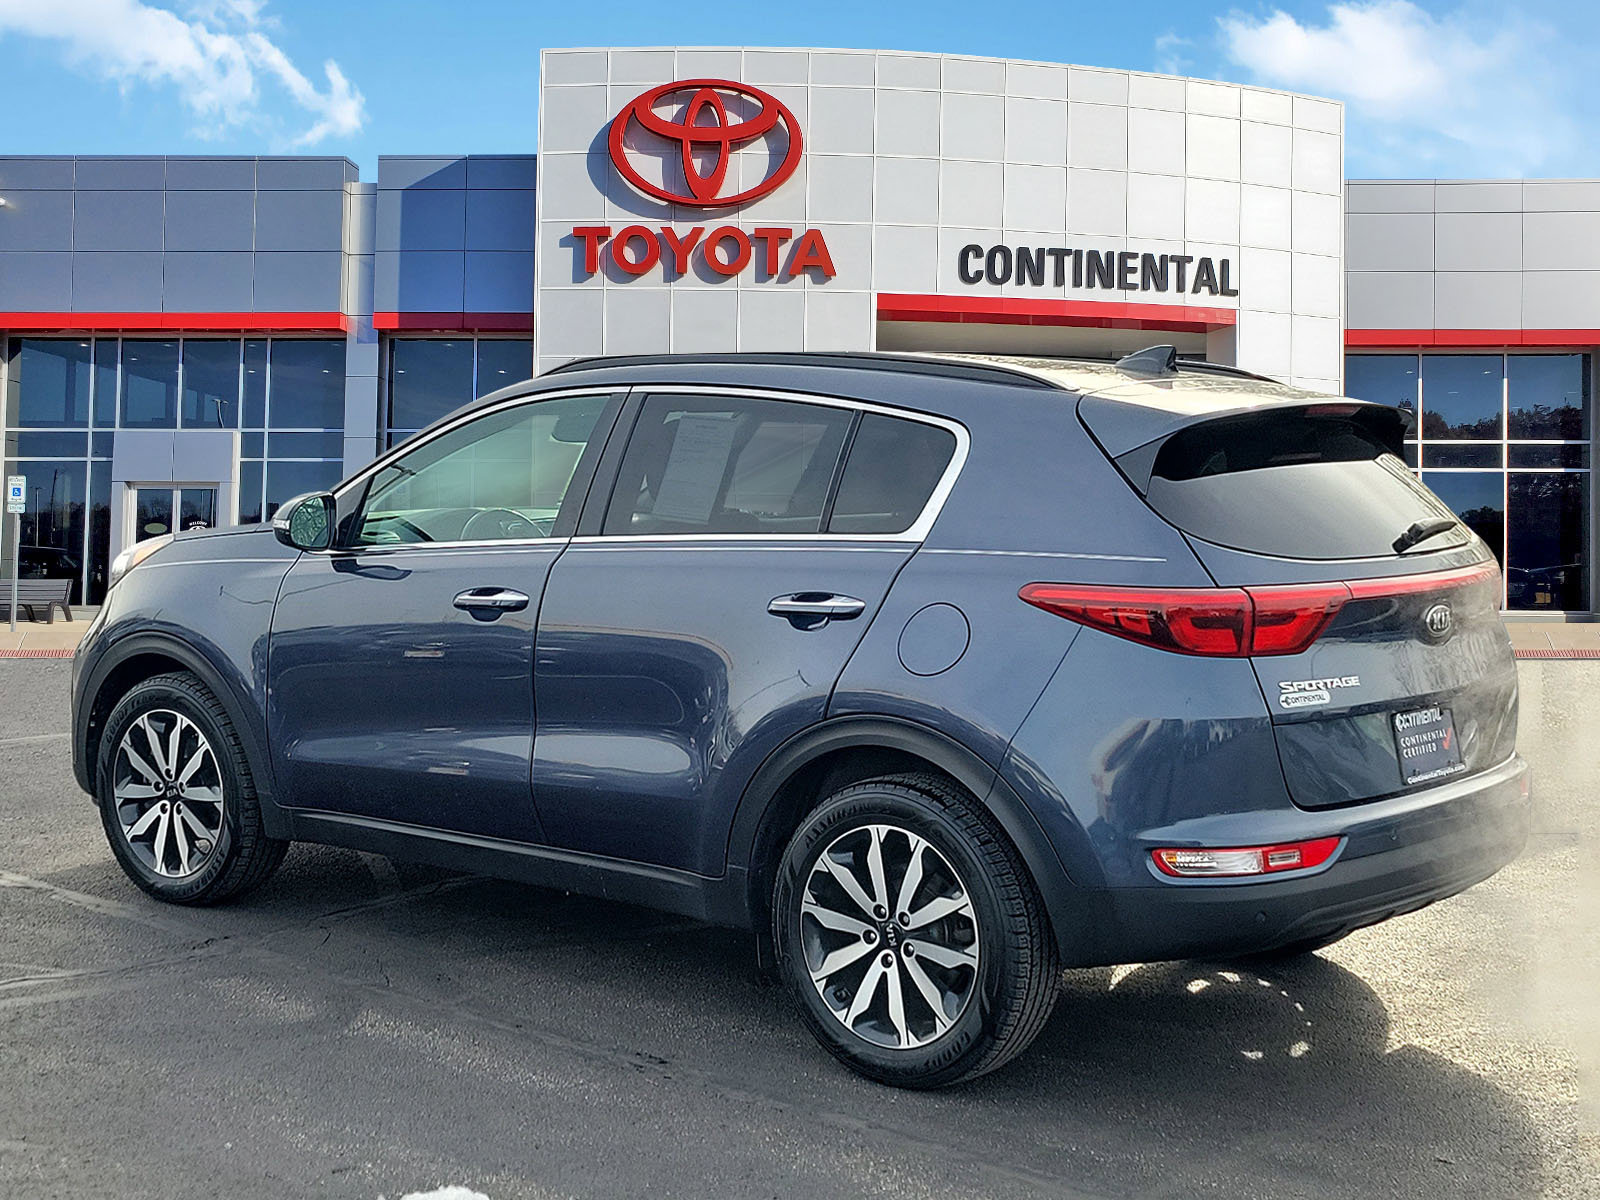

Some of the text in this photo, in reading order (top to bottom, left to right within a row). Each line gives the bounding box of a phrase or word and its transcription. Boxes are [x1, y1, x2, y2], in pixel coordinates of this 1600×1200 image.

[573, 225, 837, 277] TOYOTA
[958, 244, 1239, 297] CONTINENTAL
[1279, 676, 1361, 693] SPORTAGE
[1400, 728, 1448, 748] CONTINENTAL
[1402, 742, 1437, 759] CERTIFIED
